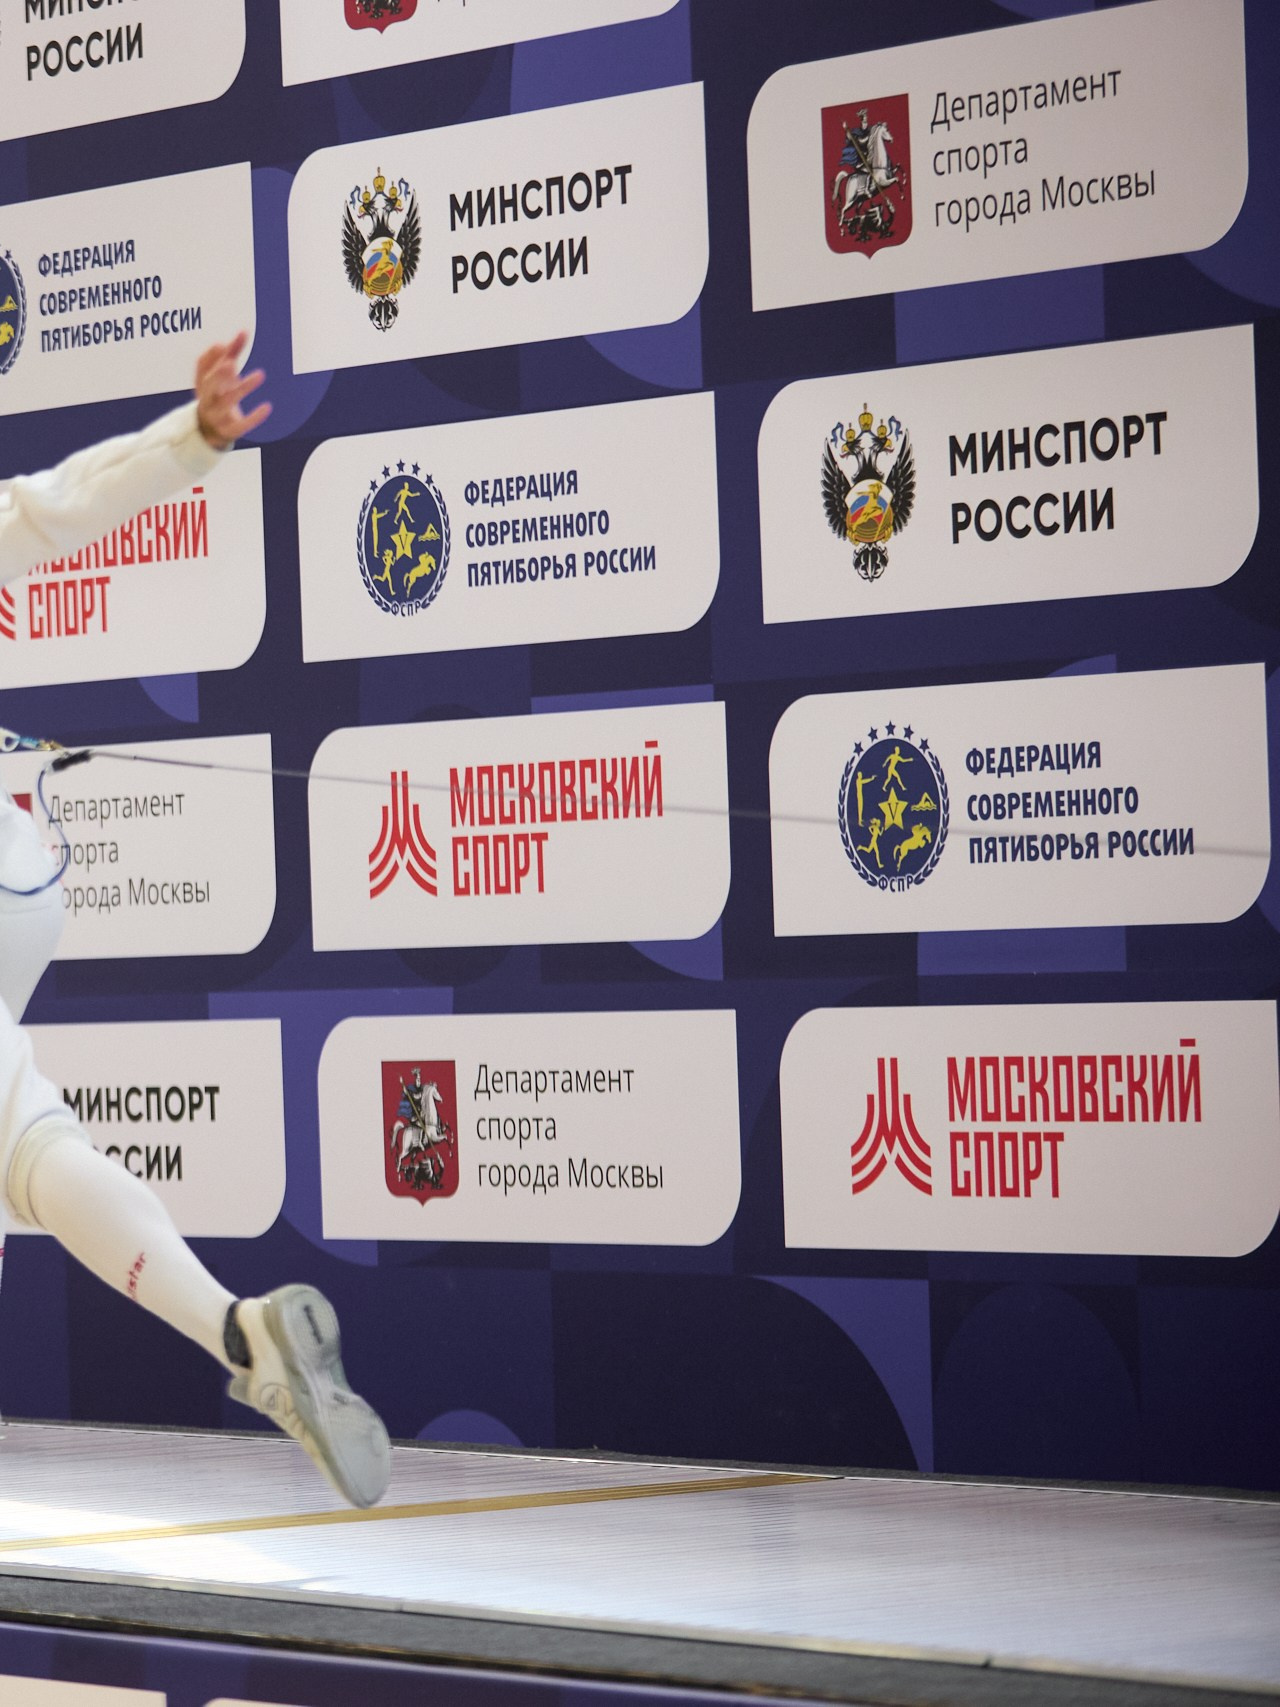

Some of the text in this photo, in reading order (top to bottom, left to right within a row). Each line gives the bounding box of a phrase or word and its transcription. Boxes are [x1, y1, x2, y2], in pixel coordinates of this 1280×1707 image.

[26, 22, 143, 81] РОССИИ
[930, 69, 1121, 134] Департамент
[932, 137, 1028, 179] спорта
[449, 164, 632, 232] МИНСПОРТ
[934, 169, 1155, 233] города Москвы
[38, 239, 135, 277] ФЕДЕРАЦИЯ
[451, 235, 588, 294] РОССИИ
[39, 275, 162, 316] СОВРЕМЕННОГО
[41, 306, 202, 353] ПЯТИБОРЬЯ РОССИИ
[949, 411, 1167, 476] МИНСПОРТ
[464, 469, 578, 507] ФЕДЕРАЦИЯ
[465, 509, 609, 548] СОВРЕМЕННОГО
[951, 486, 1115, 545] РОССИИ
[467, 545, 656, 588] ПЯТИБОРЬЯ РОССИИ
[28, 576, 111, 640] СПОРТ
[391, 600, 421, 617] ФСПР
[965, 741, 1101, 778] ФЕДЕРАЦИЯ
[449, 740, 663, 827] МОСКОВСКИЙ
[966, 786, 1139, 821] СОВРЕМЕННОГО
[48, 793, 185, 829] Департамент
[452, 832, 548, 897] СПОРТ
[968, 827, 1195, 864] ПЯТИБОРЬЯ РОССИИ
[63, 878, 210, 918] орода Москвы
[878, 874, 914, 892] ФСПР
[474, 1064, 634, 1102] Департамент
[947, 1038, 1201, 1122] МОСКОВСКИЙ
[63, 1086, 220, 1122] МИНСПОРТ
[476, 1116, 557, 1149] спорта
[478, 1157, 663, 1196] города Москвы
[949, 1131, 1064, 1198] СПОРТ
